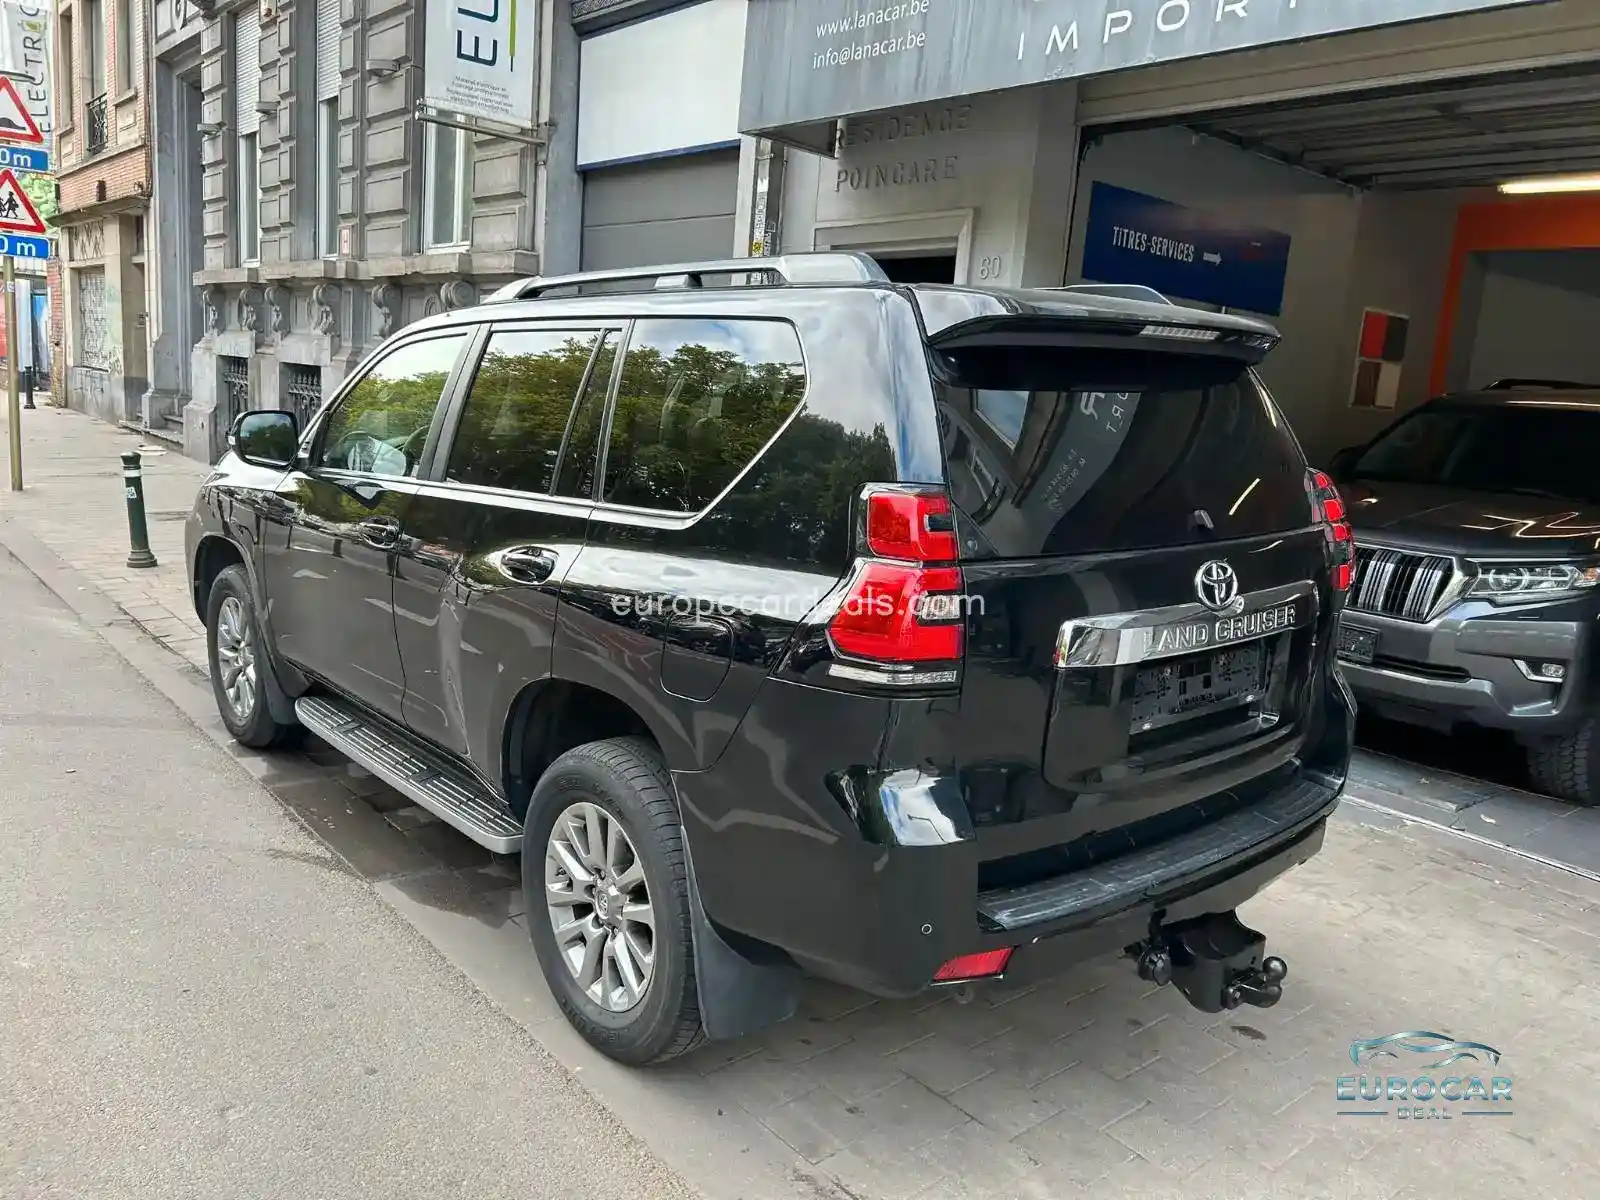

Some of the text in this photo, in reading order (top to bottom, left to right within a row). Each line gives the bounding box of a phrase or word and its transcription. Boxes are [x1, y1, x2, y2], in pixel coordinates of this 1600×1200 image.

[816, 0, 930, 38] www.lanacar.be
[1016, 0, 1298, 60] IMPOR
[812, 29, 927, 69] info@lanacar.be
[978, 255, 1001, 280] 60
[1143, 603, 1297, 653] LAND CRUISER
